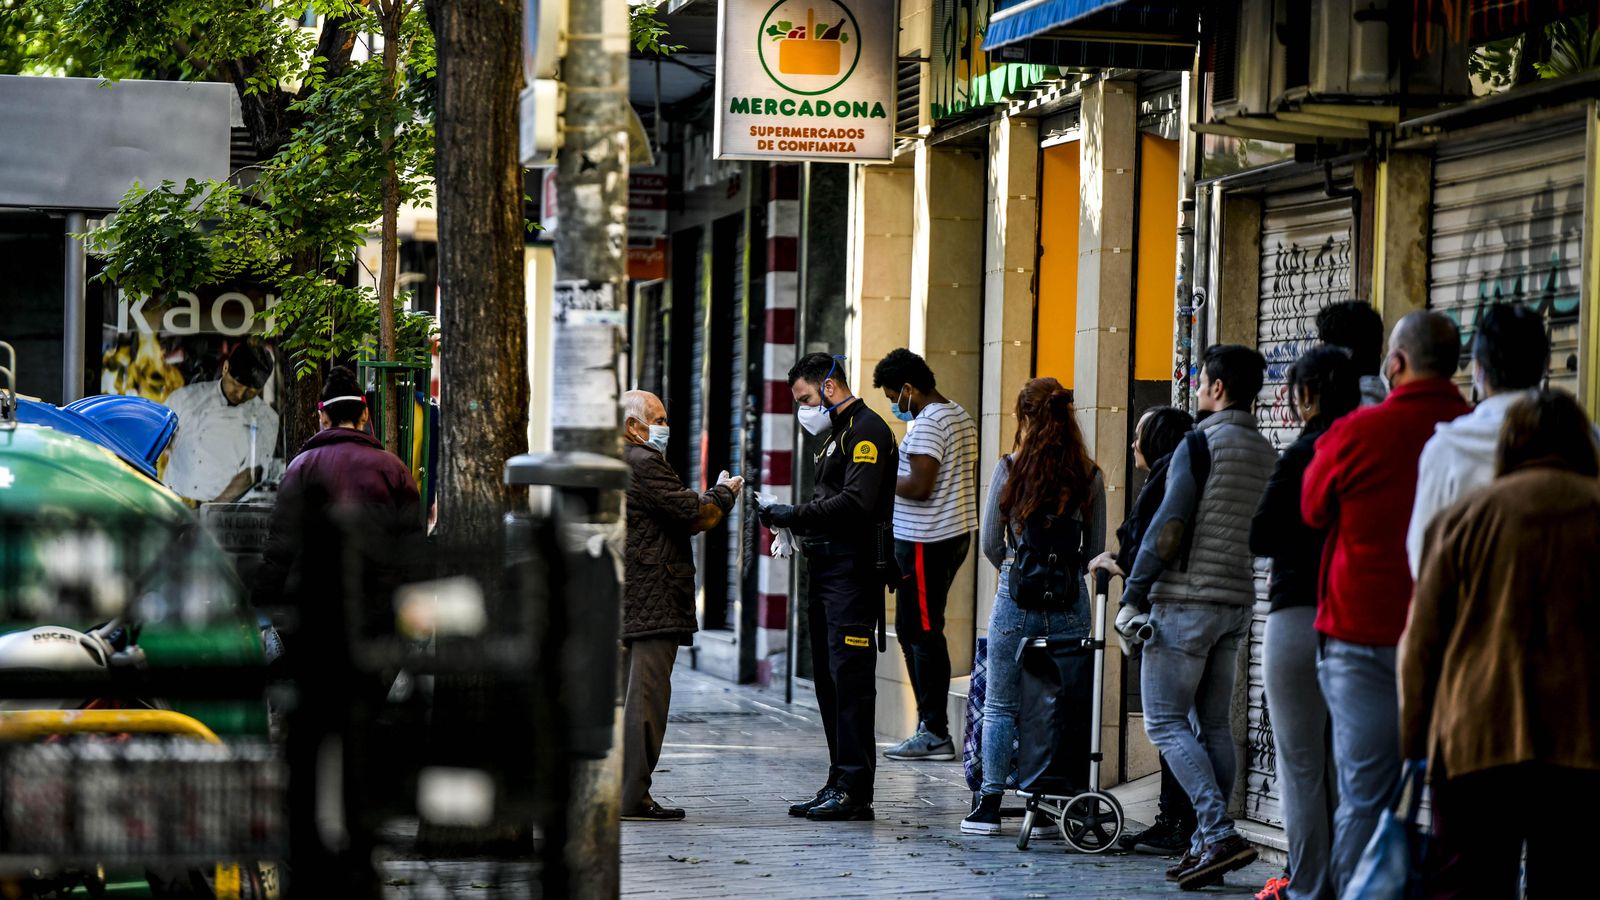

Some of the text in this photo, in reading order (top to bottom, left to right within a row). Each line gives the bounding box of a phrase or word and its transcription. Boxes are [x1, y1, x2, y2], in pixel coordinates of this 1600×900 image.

[729, 97, 886, 119] MERCADONA
[750, 125, 865, 139] SUPERMERCADOS
[757, 139, 856, 153] DE CONFIANZA
